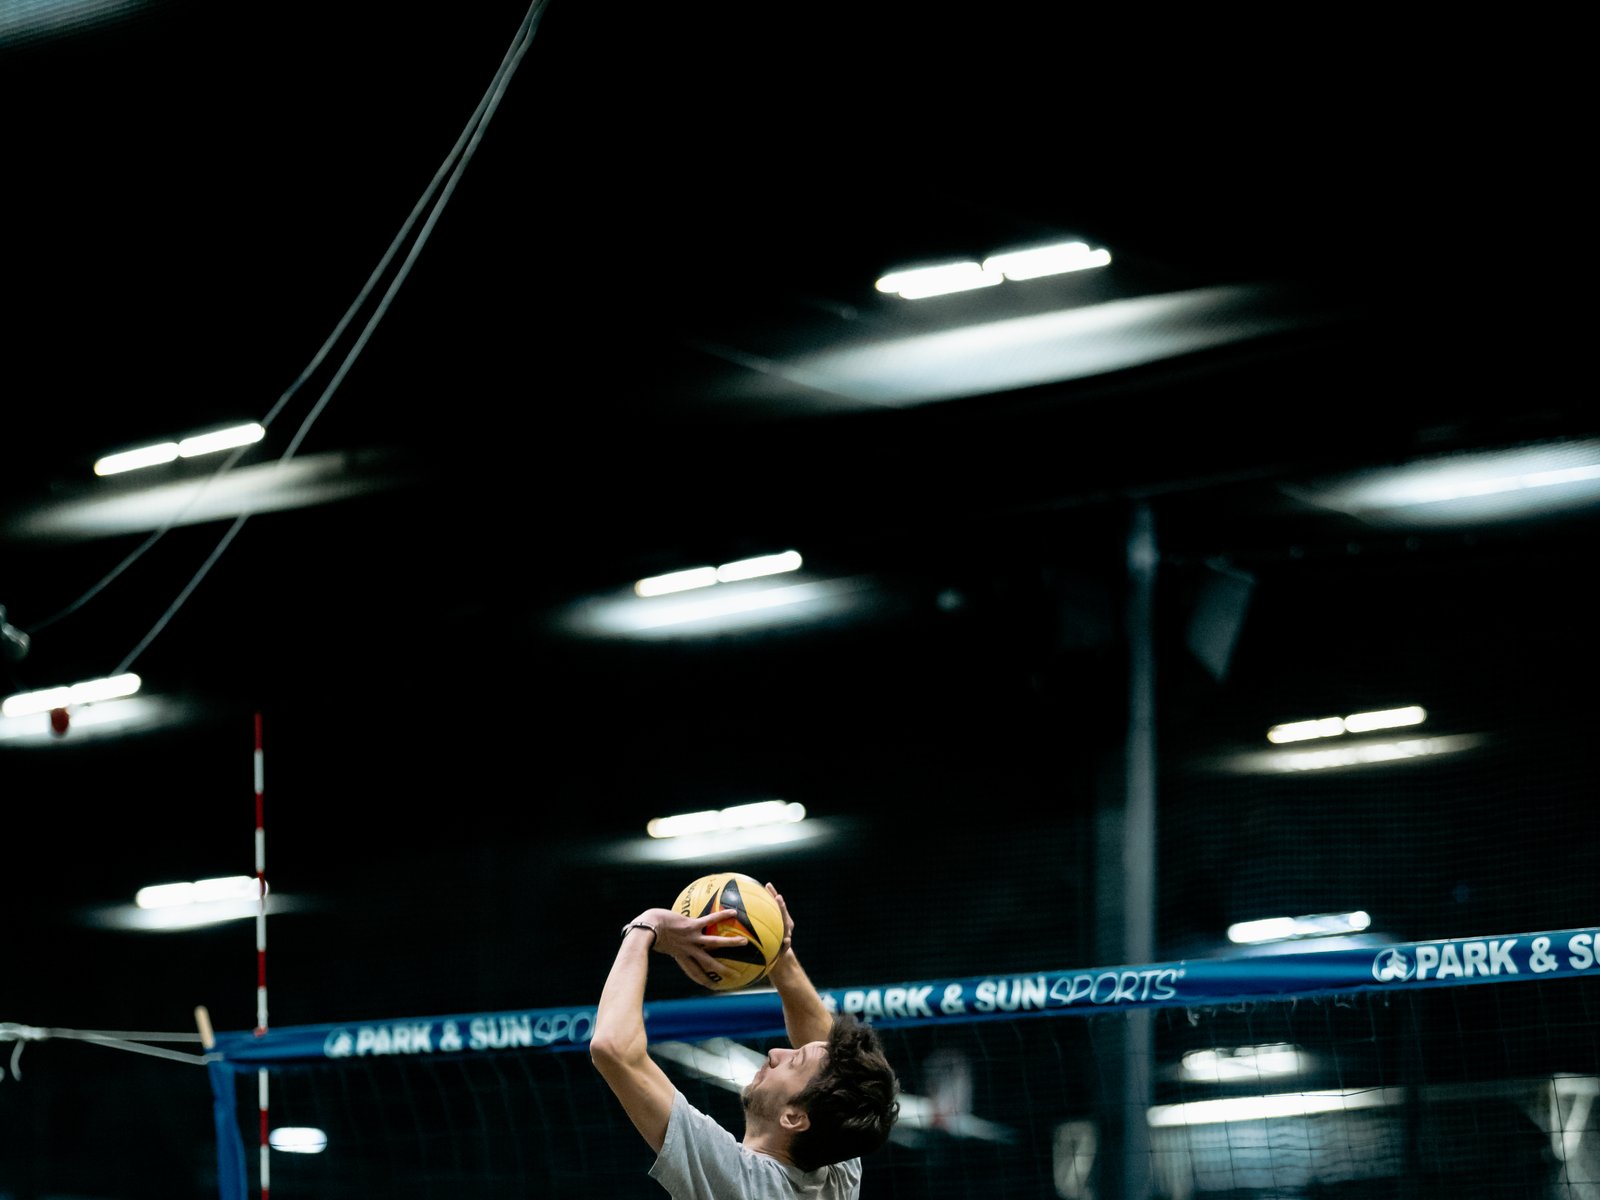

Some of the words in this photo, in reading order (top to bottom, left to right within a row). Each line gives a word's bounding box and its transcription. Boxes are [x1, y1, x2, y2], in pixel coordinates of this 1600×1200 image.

[1415, 939, 1519, 981] PARK
[1529, 936, 1559, 974] &
[843, 985, 935, 1017] PARK
[940, 983, 966, 1014] &
[974, 976, 1048, 1012] SUN
[1050, 968, 1178, 1006] SPORTS
[355, 1022, 434, 1057] PARK
[440, 1019, 463, 1051] &
[468, 1015, 533, 1050] SUN
[533, 1012, 597, 1043] SPO
